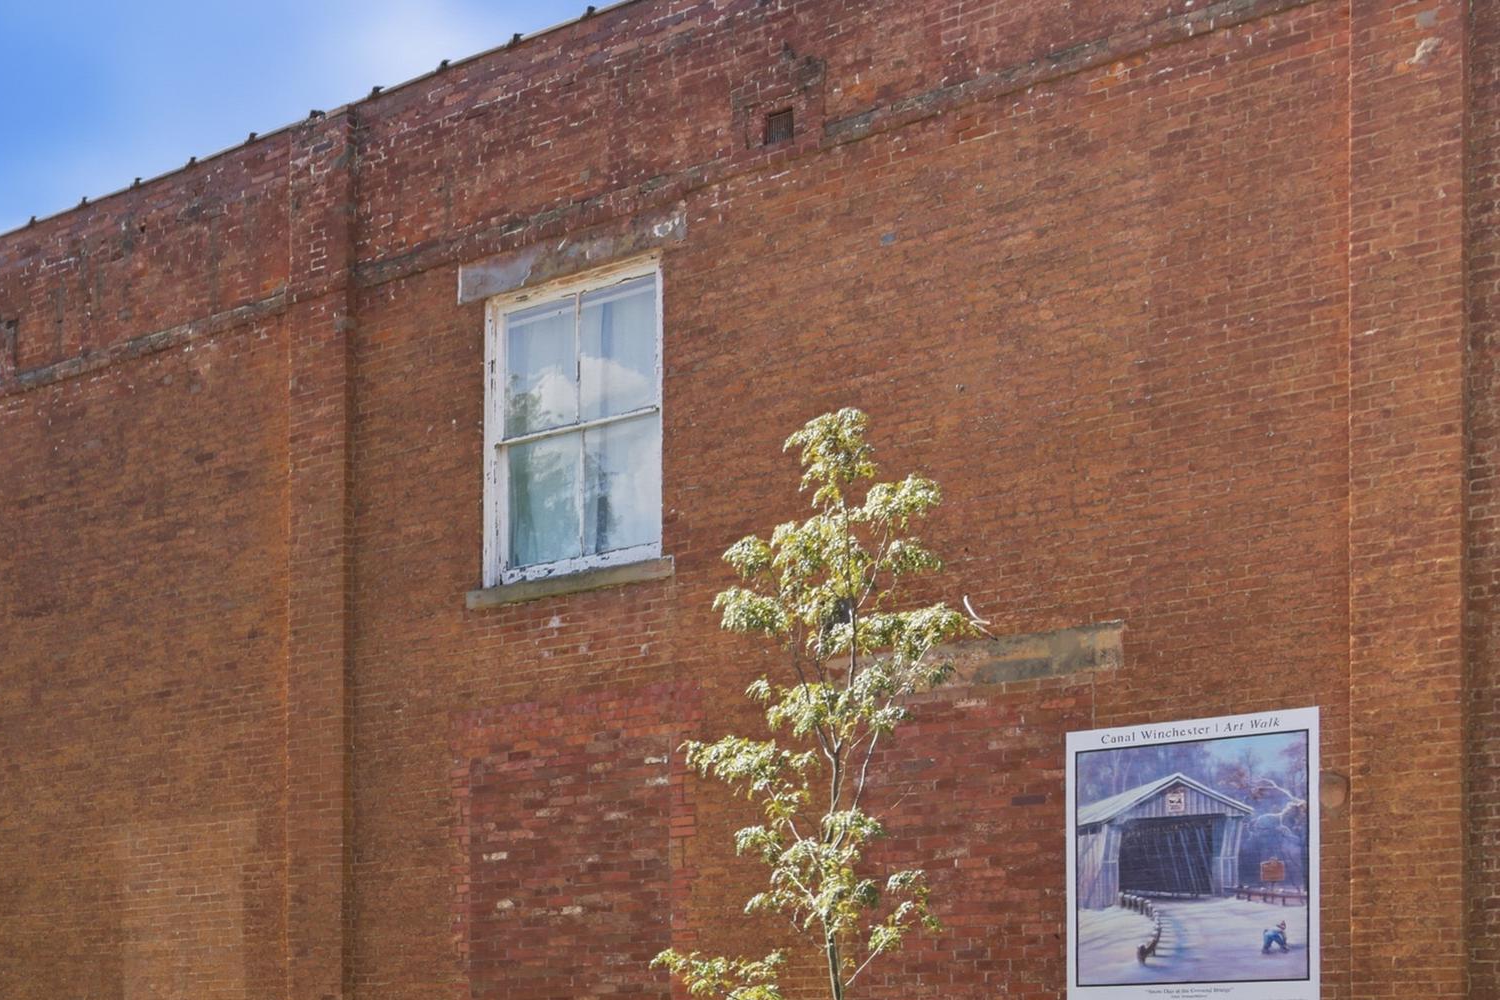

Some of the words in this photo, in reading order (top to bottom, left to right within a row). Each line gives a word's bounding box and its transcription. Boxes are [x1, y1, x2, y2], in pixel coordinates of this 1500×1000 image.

[1101, 732, 1136, 745] Canal
[1140, 726, 1210, 741] Winchester
[1223, 722, 1244, 733] Art
[1250, 717, 1281, 729] Walk
